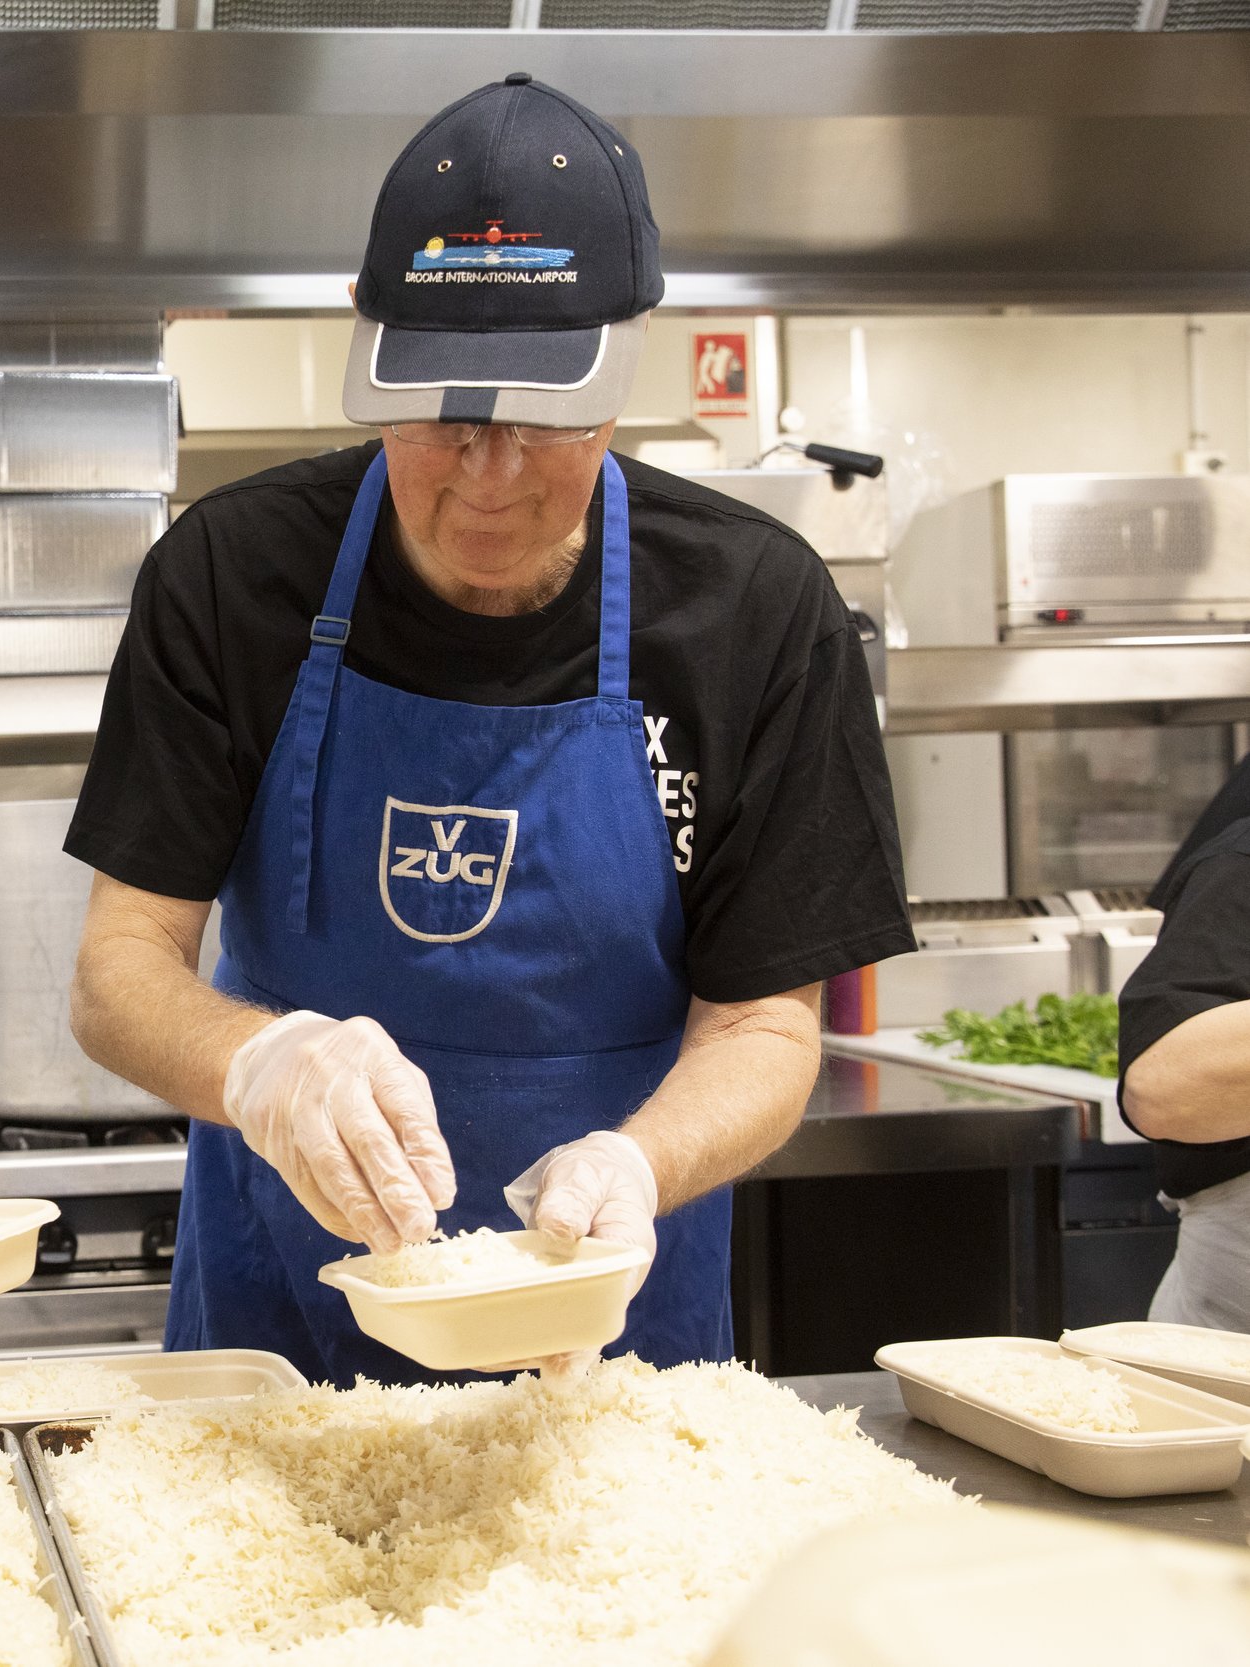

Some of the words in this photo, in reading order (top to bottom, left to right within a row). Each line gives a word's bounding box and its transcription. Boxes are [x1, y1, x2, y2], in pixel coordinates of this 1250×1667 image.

[404, 271, 444, 283] BROOME
[445, 271, 531, 284] INTERNATIONAL
[532, 271, 578, 284] AIRPORT
[651, 769, 700, 819] ES
[430, 819, 467, 852] V
[390, 846, 496, 886] ZUG
